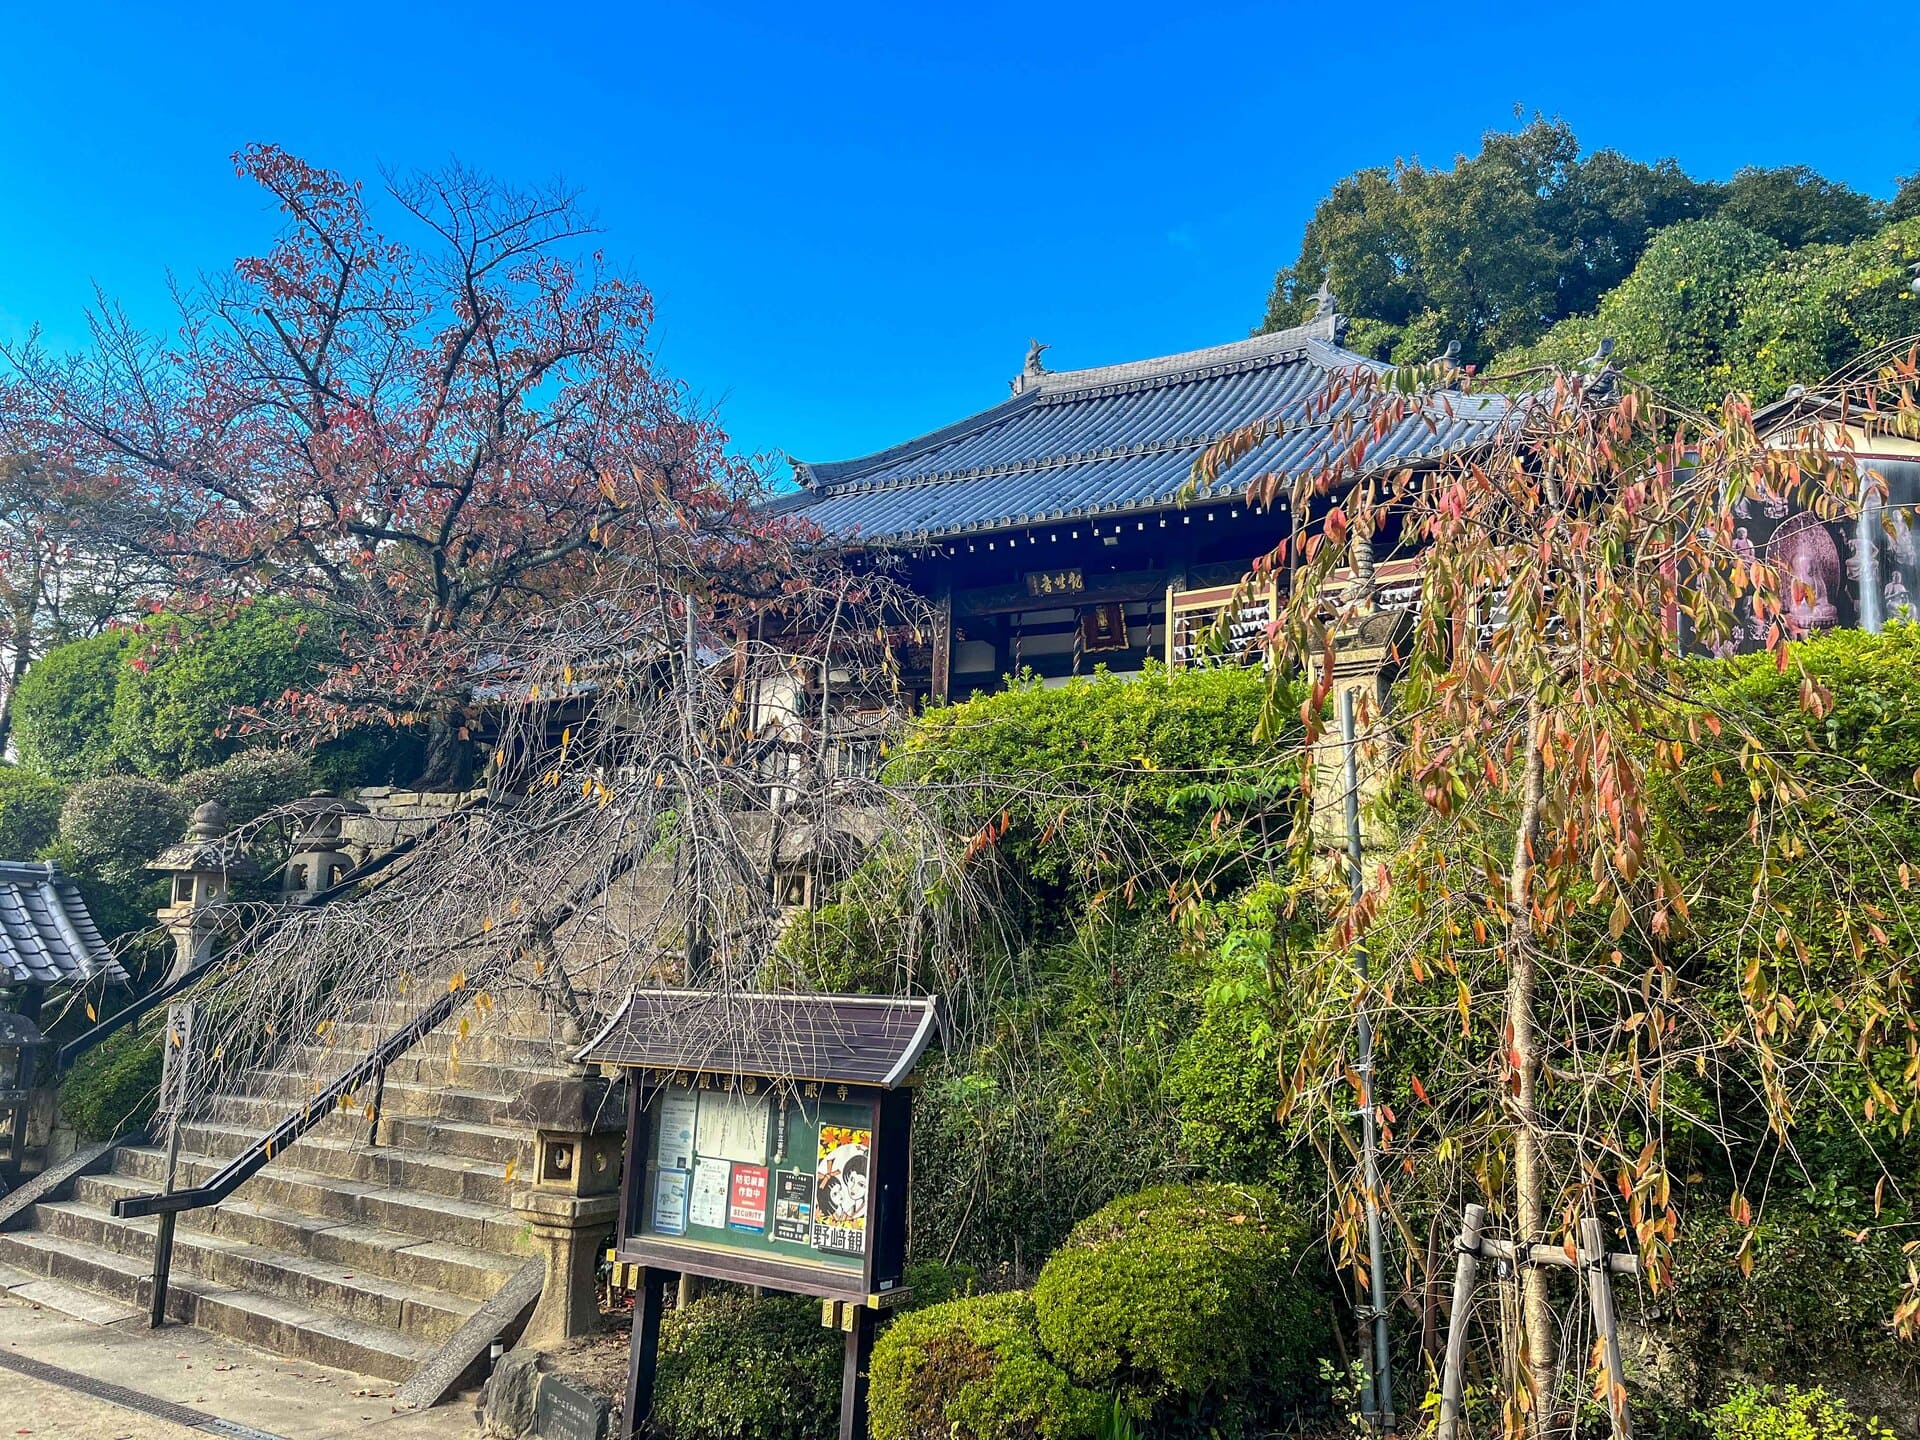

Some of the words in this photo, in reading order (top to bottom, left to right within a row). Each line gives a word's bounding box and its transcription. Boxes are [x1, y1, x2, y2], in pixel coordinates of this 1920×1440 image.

[738, 1187, 761, 1199] 作動中
[733, 1208, 762, 1220] SECURITY
